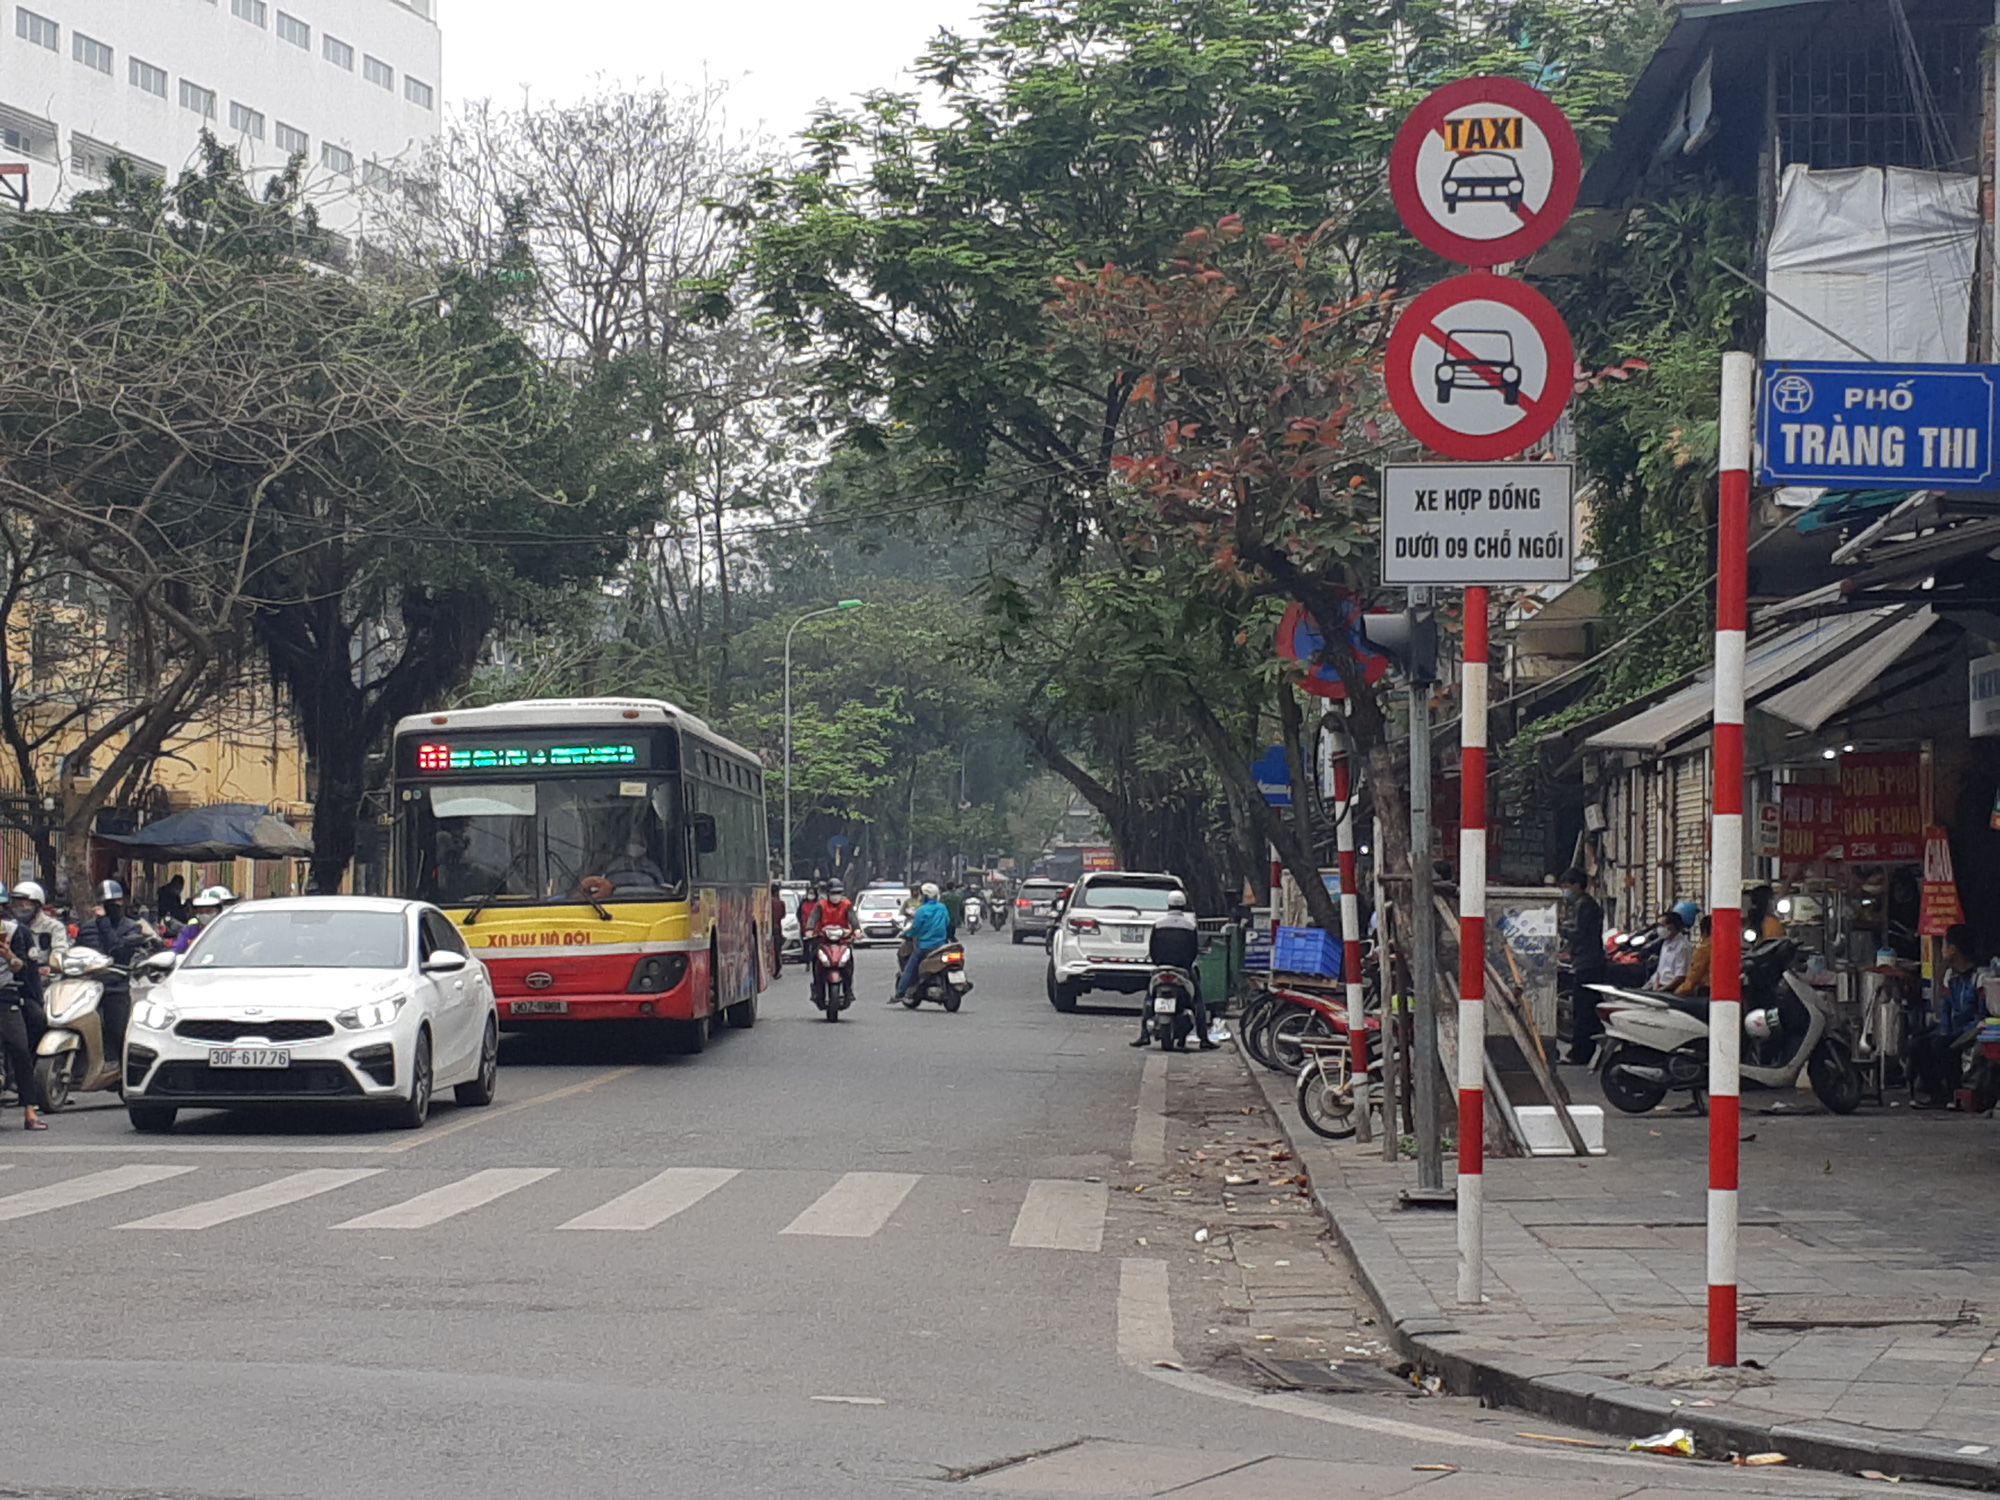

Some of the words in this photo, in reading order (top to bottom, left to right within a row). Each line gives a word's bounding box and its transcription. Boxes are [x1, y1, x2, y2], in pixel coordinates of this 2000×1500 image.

[1445, 117, 1523, 149] TAXI
[1844, 379, 1915, 411] PHỐ
[1780, 413, 1906, 468] TRÀNG
[1918, 427, 1978, 469] THI
[1414, 489, 1439, 512] XE
[1444, 488, 1482, 516] HỢP
[1395, 531, 1439, 559] DƯỚI
[1445, 537, 1468, 559] 09
[1474, 529, 1512, 559] CHỖ
[511, 932, 537, 946] BUS
[540, 930, 560, 946] HÀ
[563, 930, 592, 947] NỘI
[212, 1050, 287, 1066] 30F-617.76
